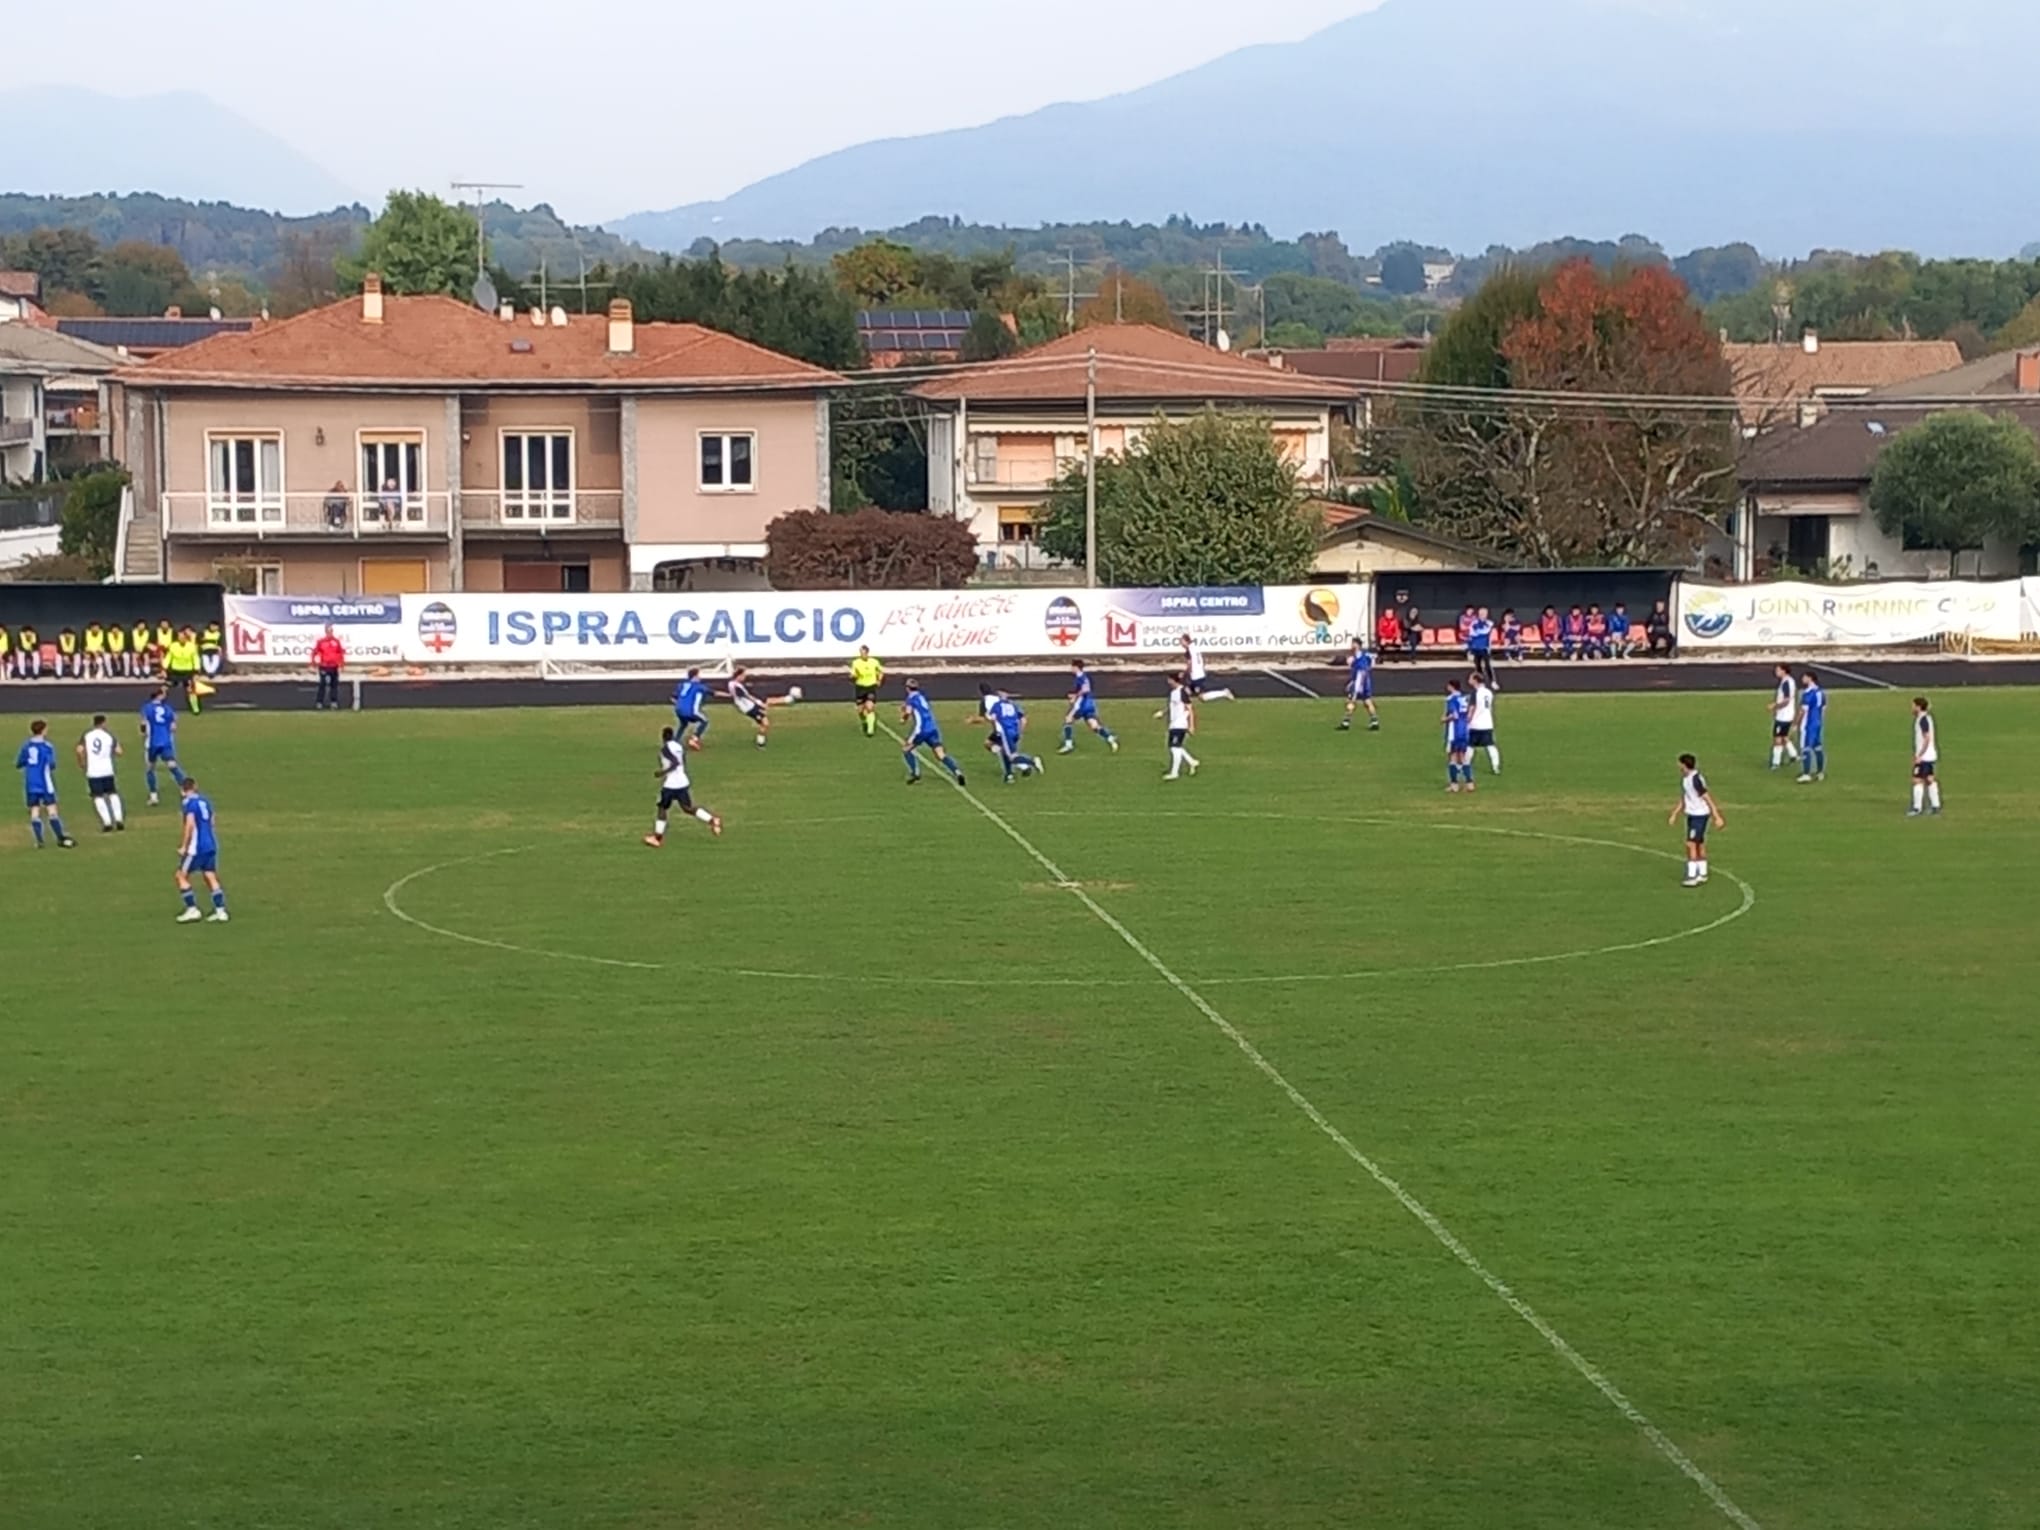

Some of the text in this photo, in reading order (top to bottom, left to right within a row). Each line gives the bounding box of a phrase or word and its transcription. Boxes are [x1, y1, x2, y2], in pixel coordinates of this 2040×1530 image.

[290, 603, 384, 616] ISPRA CENTRO
[1161, 595, 1248, 608] ISPRA CENTRO
[1746, 598, 1809, 620] JOINT
[488, 607, 865, 645] ISPRA CALCIO
[911, 624, 999, 652] insieme
[155, 706, 165, 723] 2
[92, 737, 102, 755] 9
